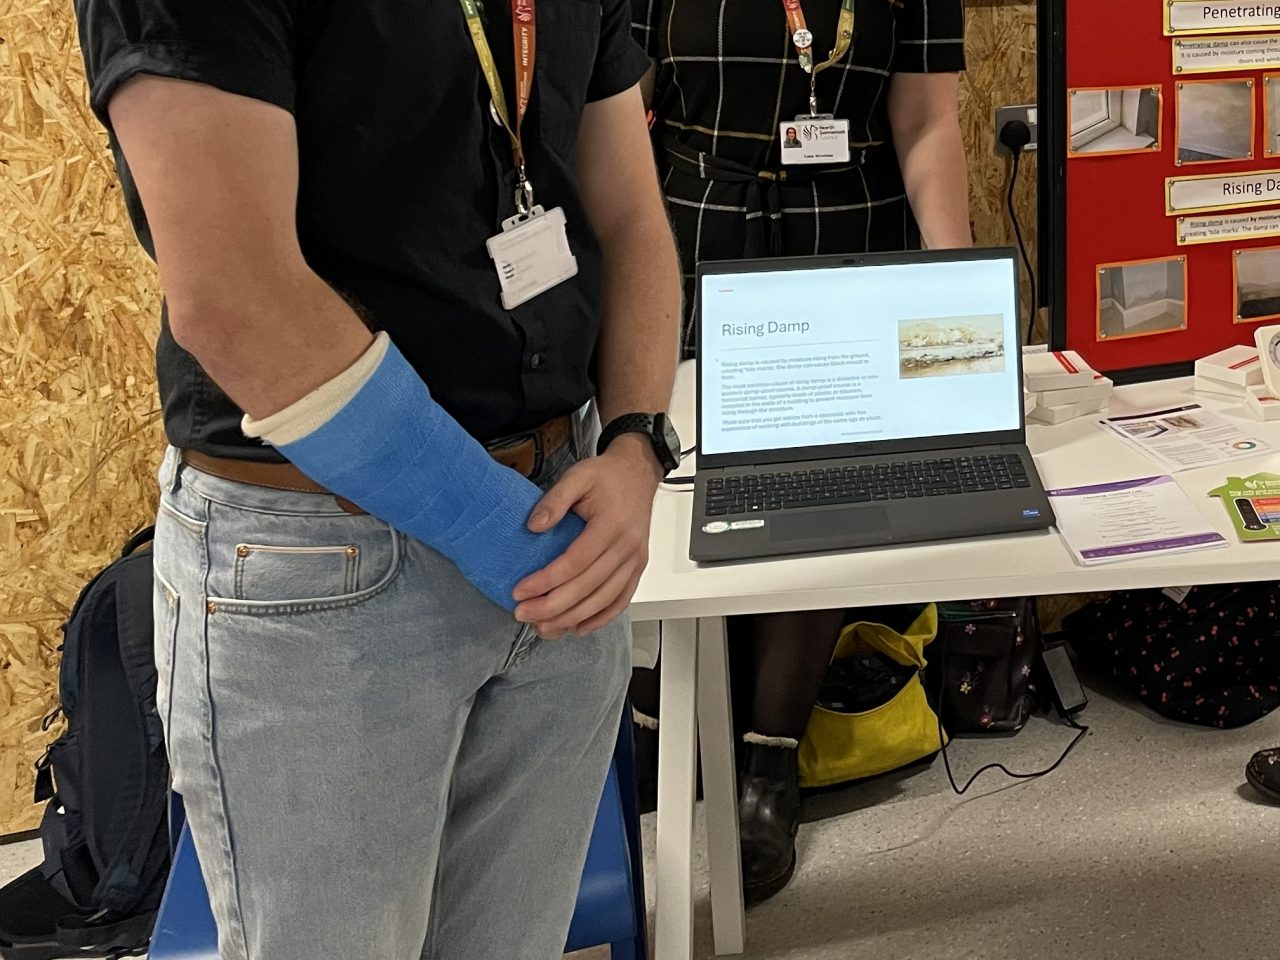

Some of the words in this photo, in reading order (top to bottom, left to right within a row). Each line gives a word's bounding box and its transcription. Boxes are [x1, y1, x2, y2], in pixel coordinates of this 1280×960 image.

[521, 26, 529, 67] INTEGRITY
[1179, 41, 1213, 50] Penetrating
[1212, 41, 1229, 49] damp
[1191, 50, 1212, 58] caused
[1212, 50, 1220, 58] by
[1220, 48, 1245, 56] moisture
[1222, 178, 1263, 198] Rising
[1190, 221, 1207, 229] Rising
[1183, 230, 1207, 238] creating
[721, 322, 765, 338] Rising
[767, 320, 810, 335] Damp
